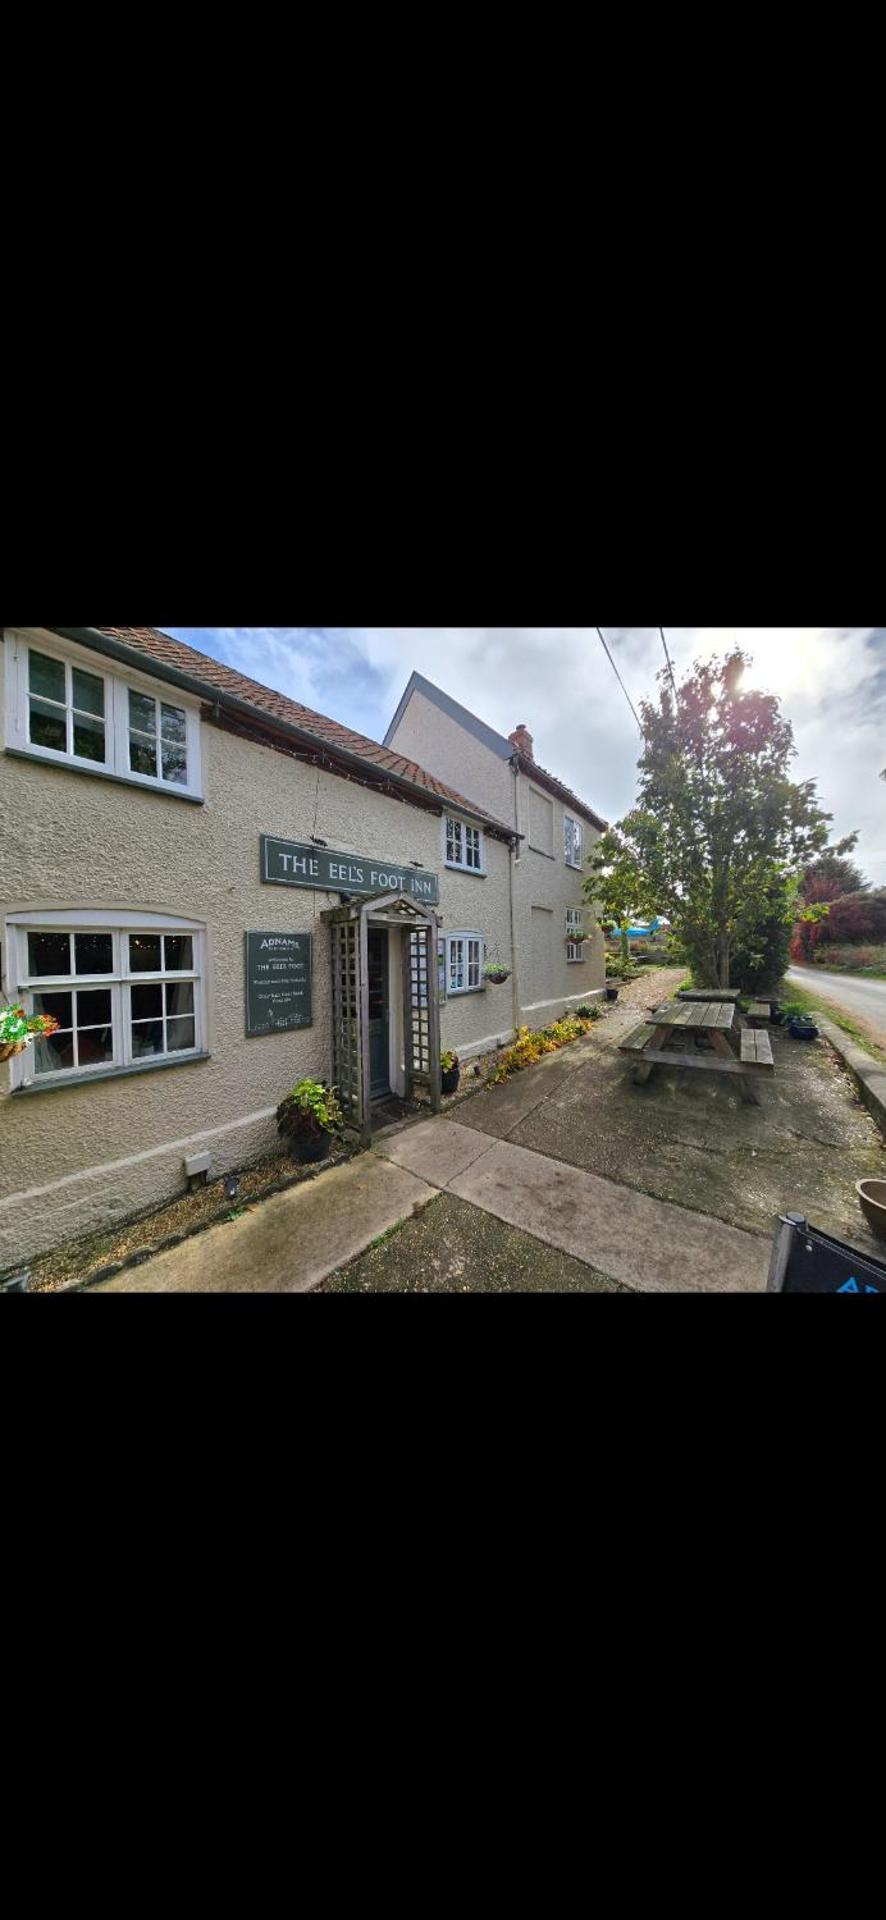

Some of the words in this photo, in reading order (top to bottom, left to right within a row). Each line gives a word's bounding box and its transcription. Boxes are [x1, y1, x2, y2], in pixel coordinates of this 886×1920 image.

[278, 853, 319, 876] THE
[329, 863, 364, 883] EEL'S
[370, 871, 405, 890] FOOT
[411, 878, 432, 894] INN
